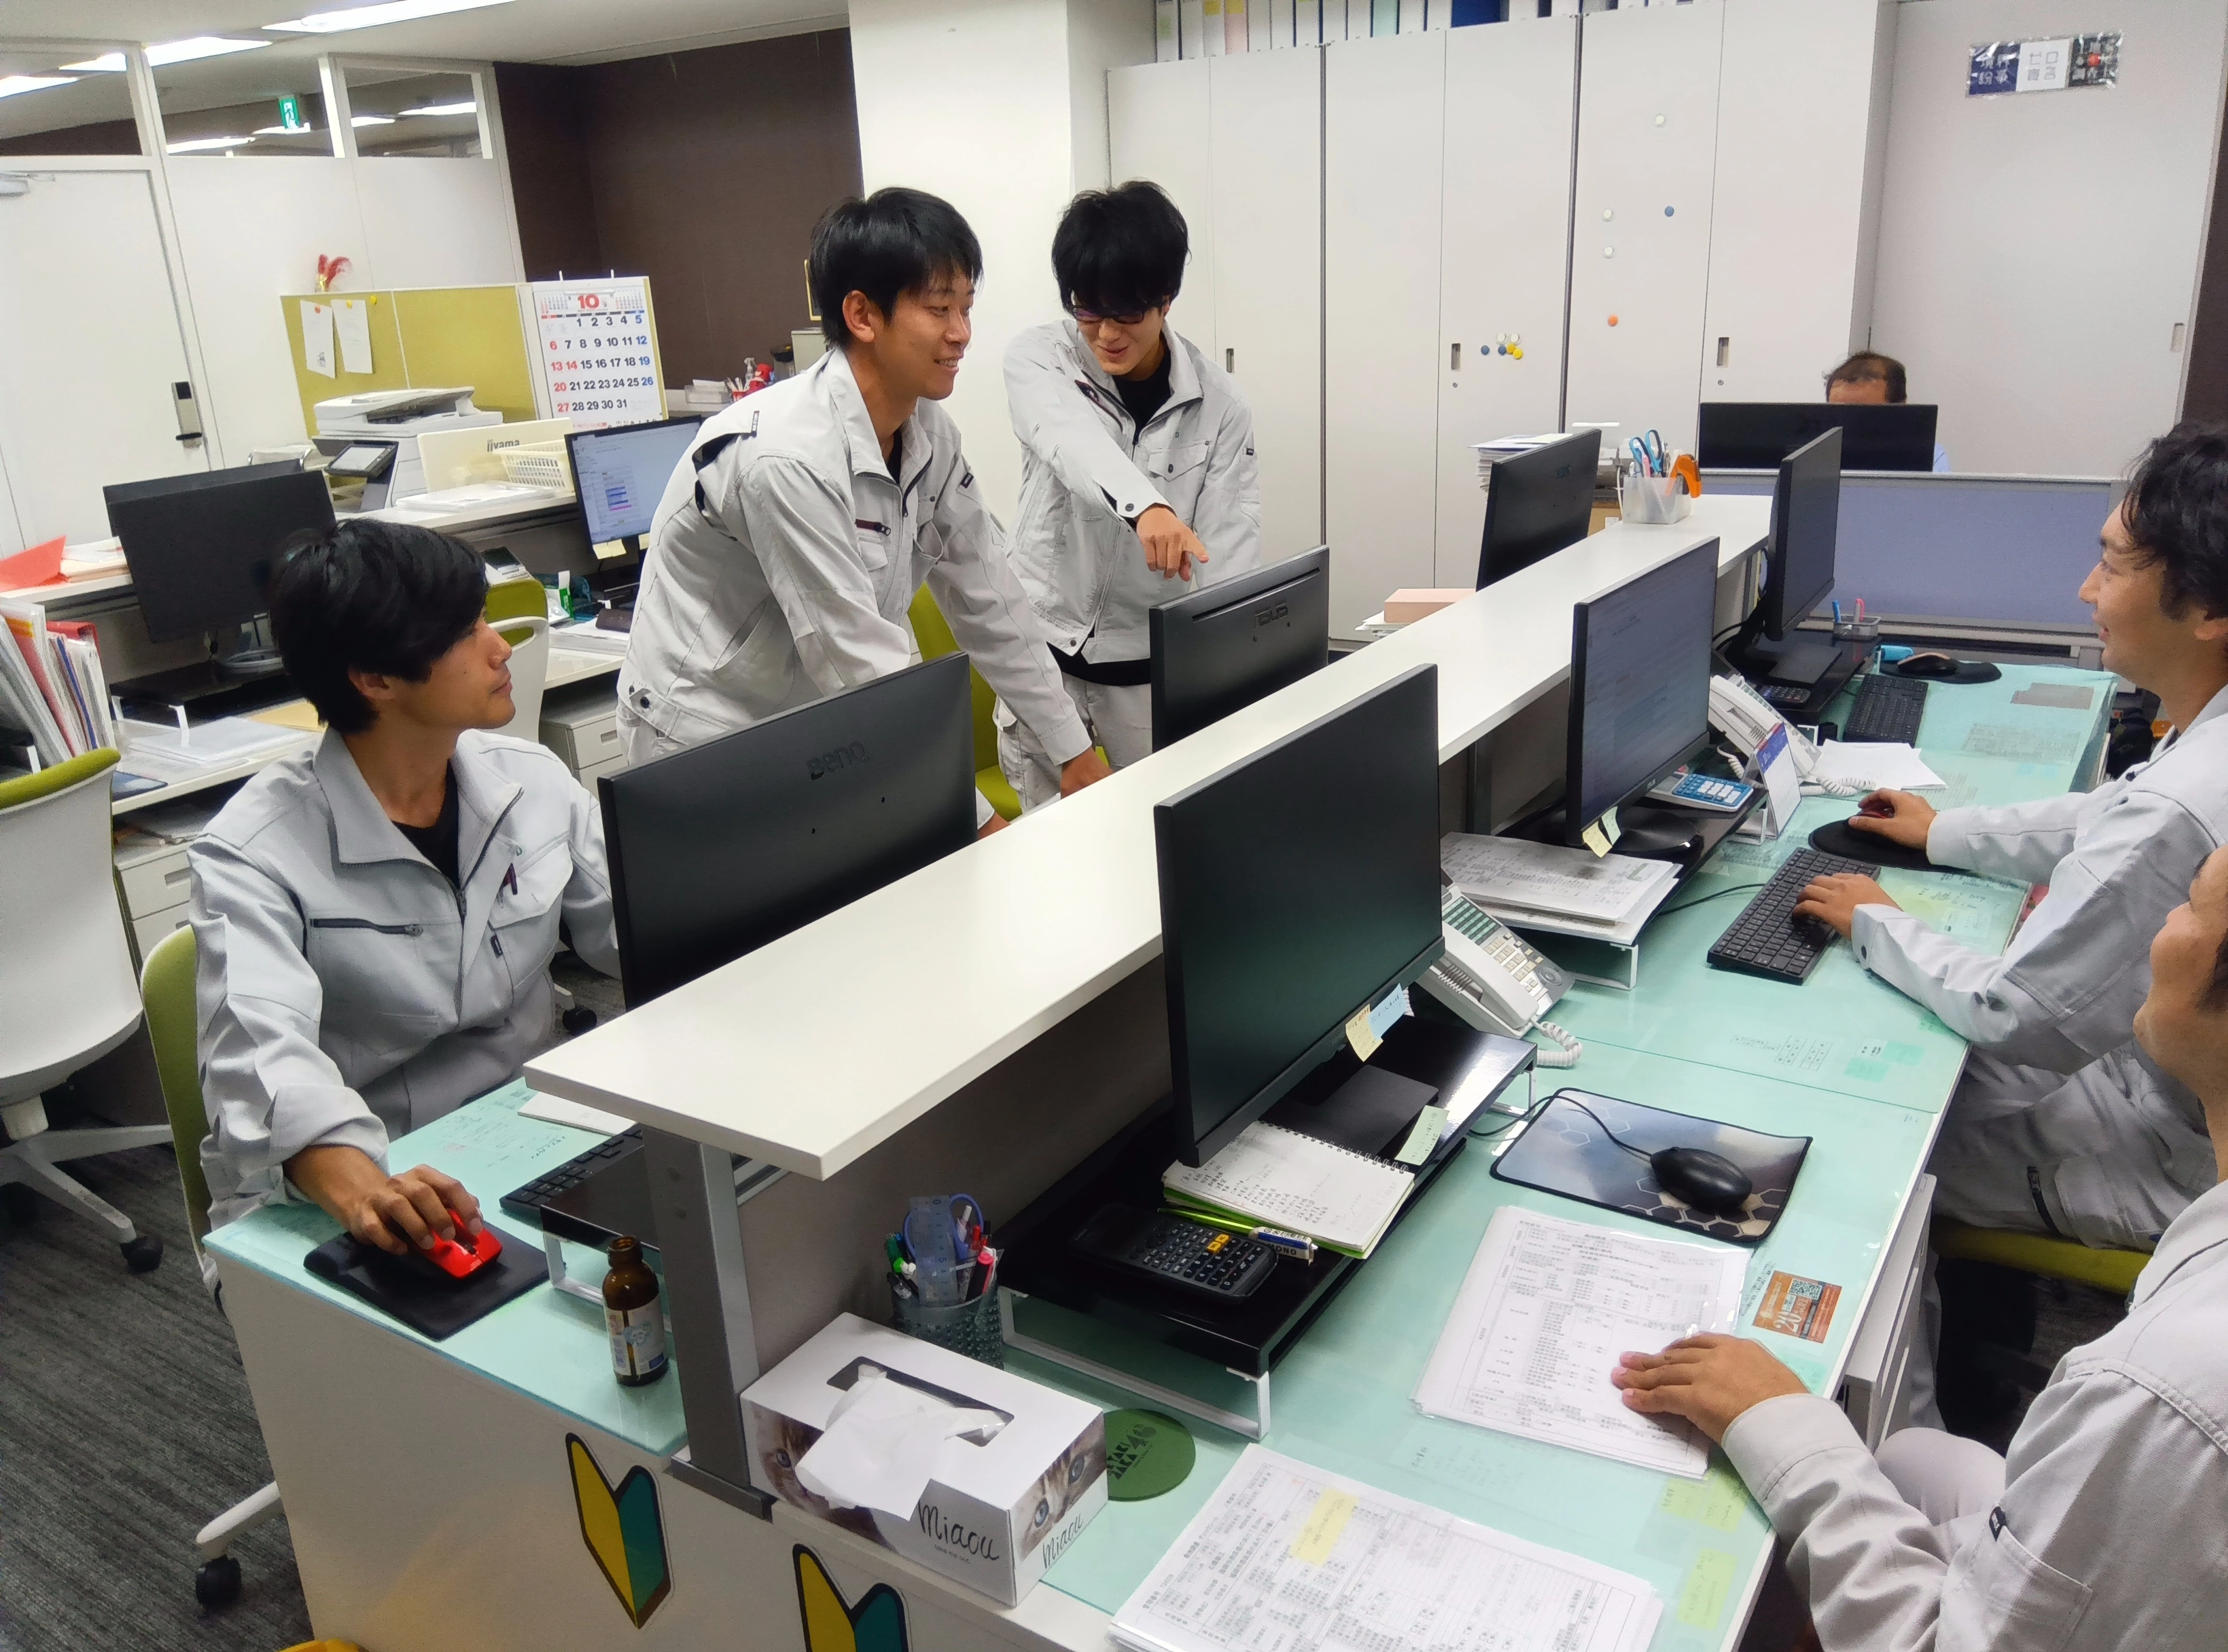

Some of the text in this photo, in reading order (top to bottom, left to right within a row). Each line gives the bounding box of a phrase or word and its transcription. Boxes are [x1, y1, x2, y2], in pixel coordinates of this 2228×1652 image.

[578, 294, 599, 308] 10
[591, 318, 598, 327] 2
[606, 317, 613, 326] 3
[635, 315, 642, 324] 5
[550, 336, 647, 350] 6 7 8 9 10 11 12
[551, 356, 650, 371] 13 14 15 16 17 18 19
[554, 377, 653, 392] 20 21 22 23 24 25 26
[558, 399, 627, 412] 27 28 29 30 31
[1269, 1244, 1297, 1255] ONO
[918, 1501, 1000, 1561] Miaou
[1042, 1513, 1083, 1569] Miaou
